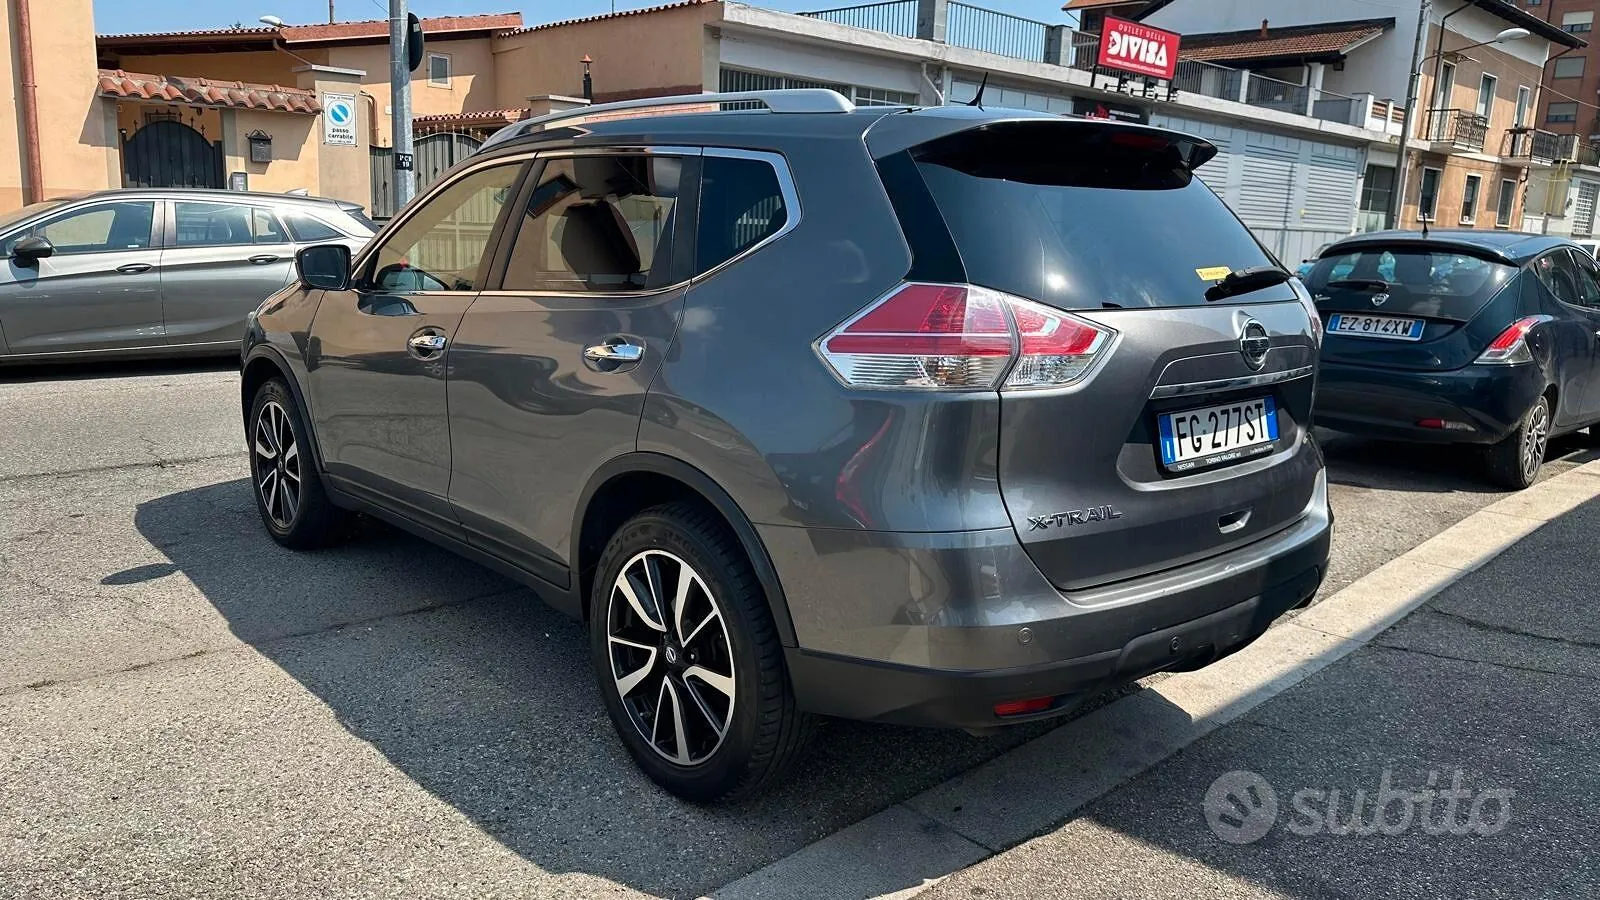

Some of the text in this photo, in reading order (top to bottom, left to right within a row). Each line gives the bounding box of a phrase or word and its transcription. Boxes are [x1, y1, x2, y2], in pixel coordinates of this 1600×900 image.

[1118, 23, 1167, 42] OUTLET DELLA
[1107, 30, 1168, 67] DIVISA
[1339, 316, 1413, 336] EZ 814XW
[1175, 403, 1264, 457] FG 277ST
[1177, 461, 1195, 471] NISSAN
[1221, 453, 1236, 461] VALORE
[1027, 504, 1123, 531] X-TRAIL
